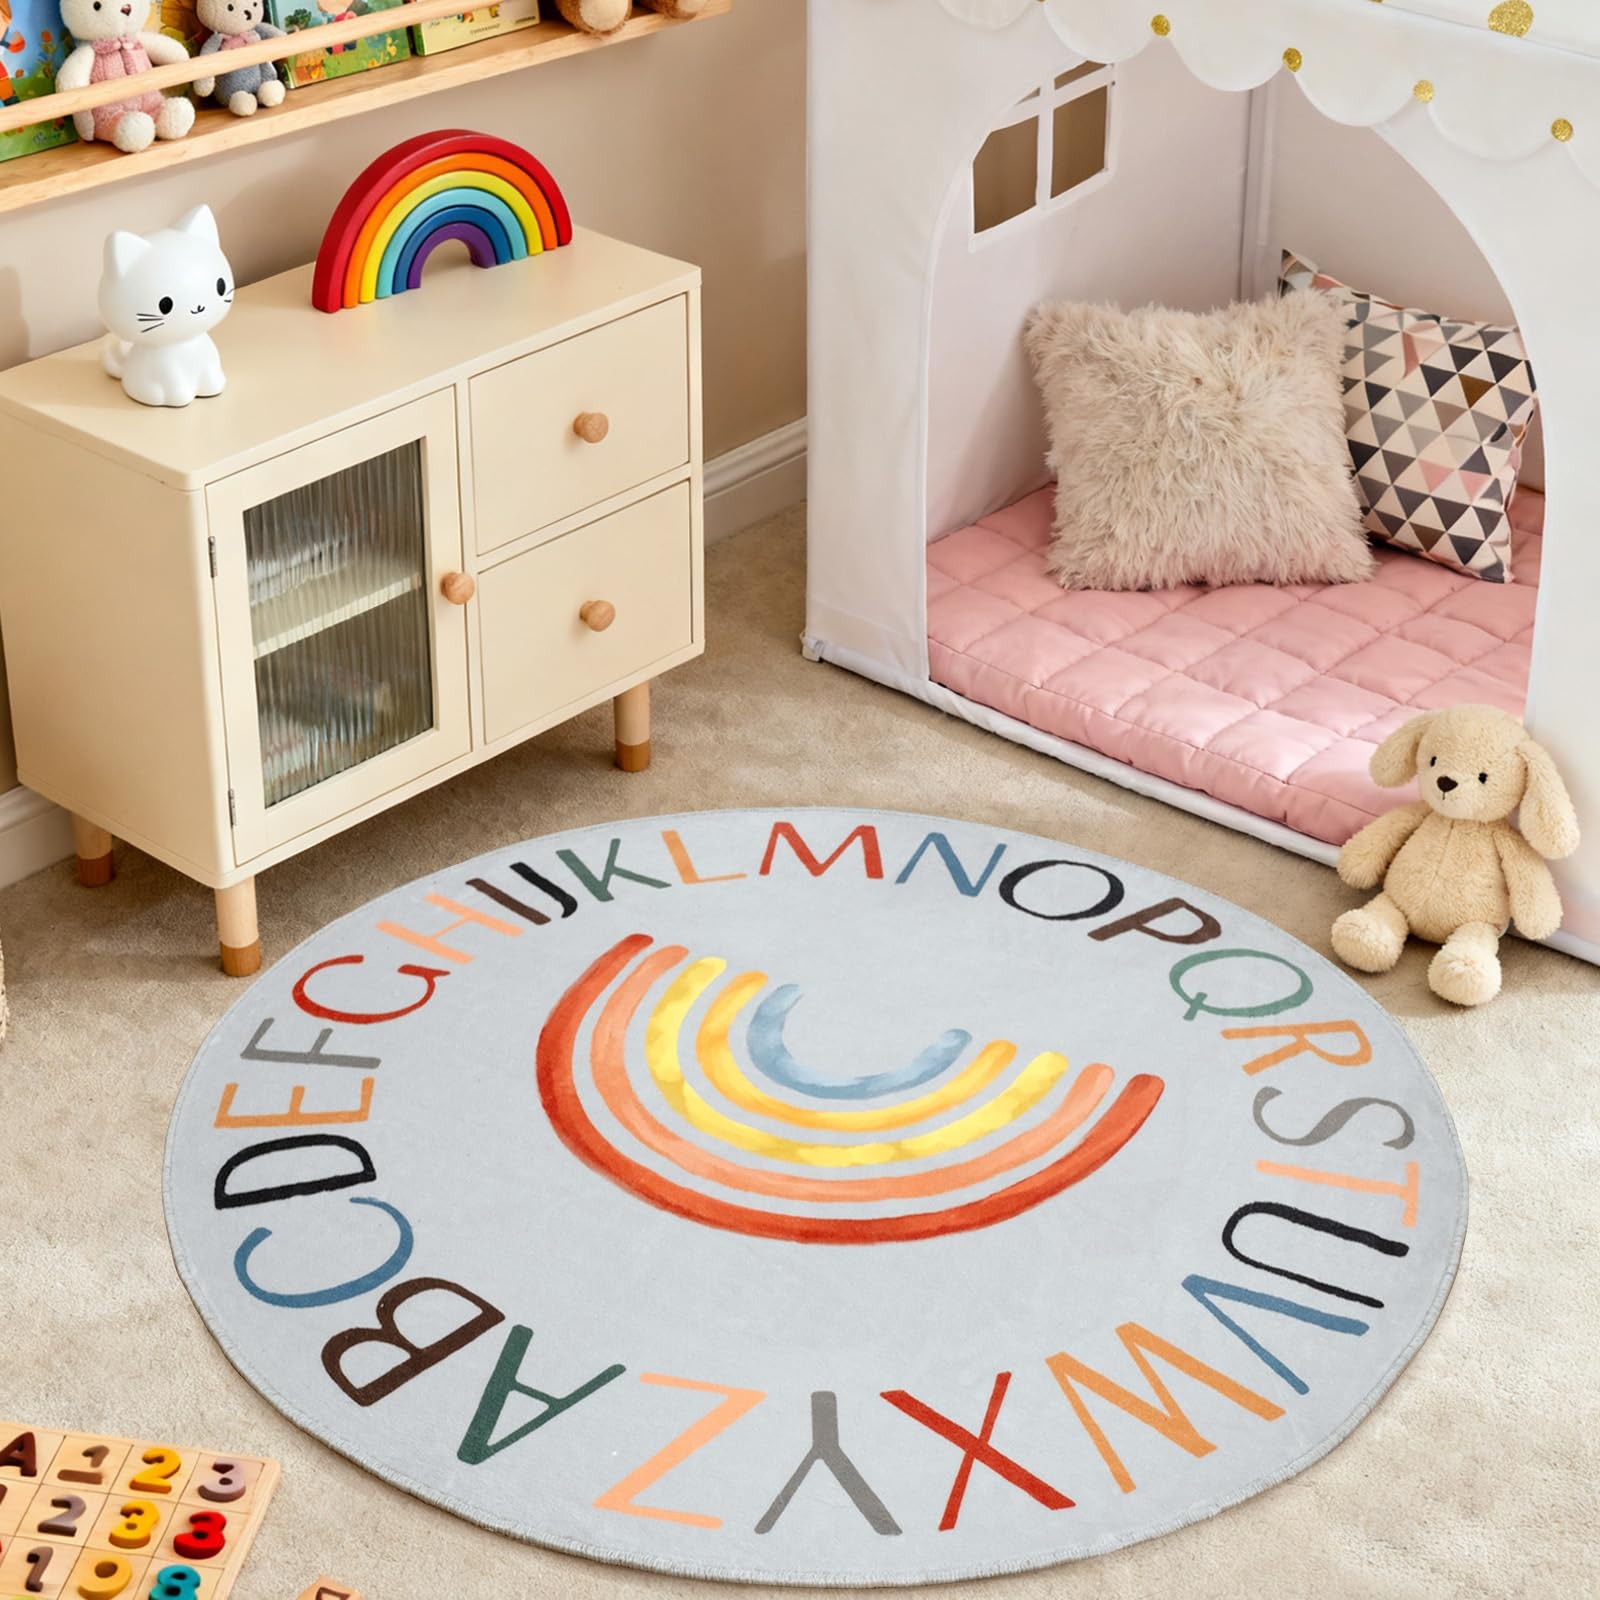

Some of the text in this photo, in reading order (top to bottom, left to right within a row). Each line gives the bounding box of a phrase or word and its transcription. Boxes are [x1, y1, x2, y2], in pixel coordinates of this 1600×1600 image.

[0, 1432, 246, 1503] A 1 2 3
[37, 1495, 226, 1560] 2 3 3
[25, 1546, 54, 1592] 1
